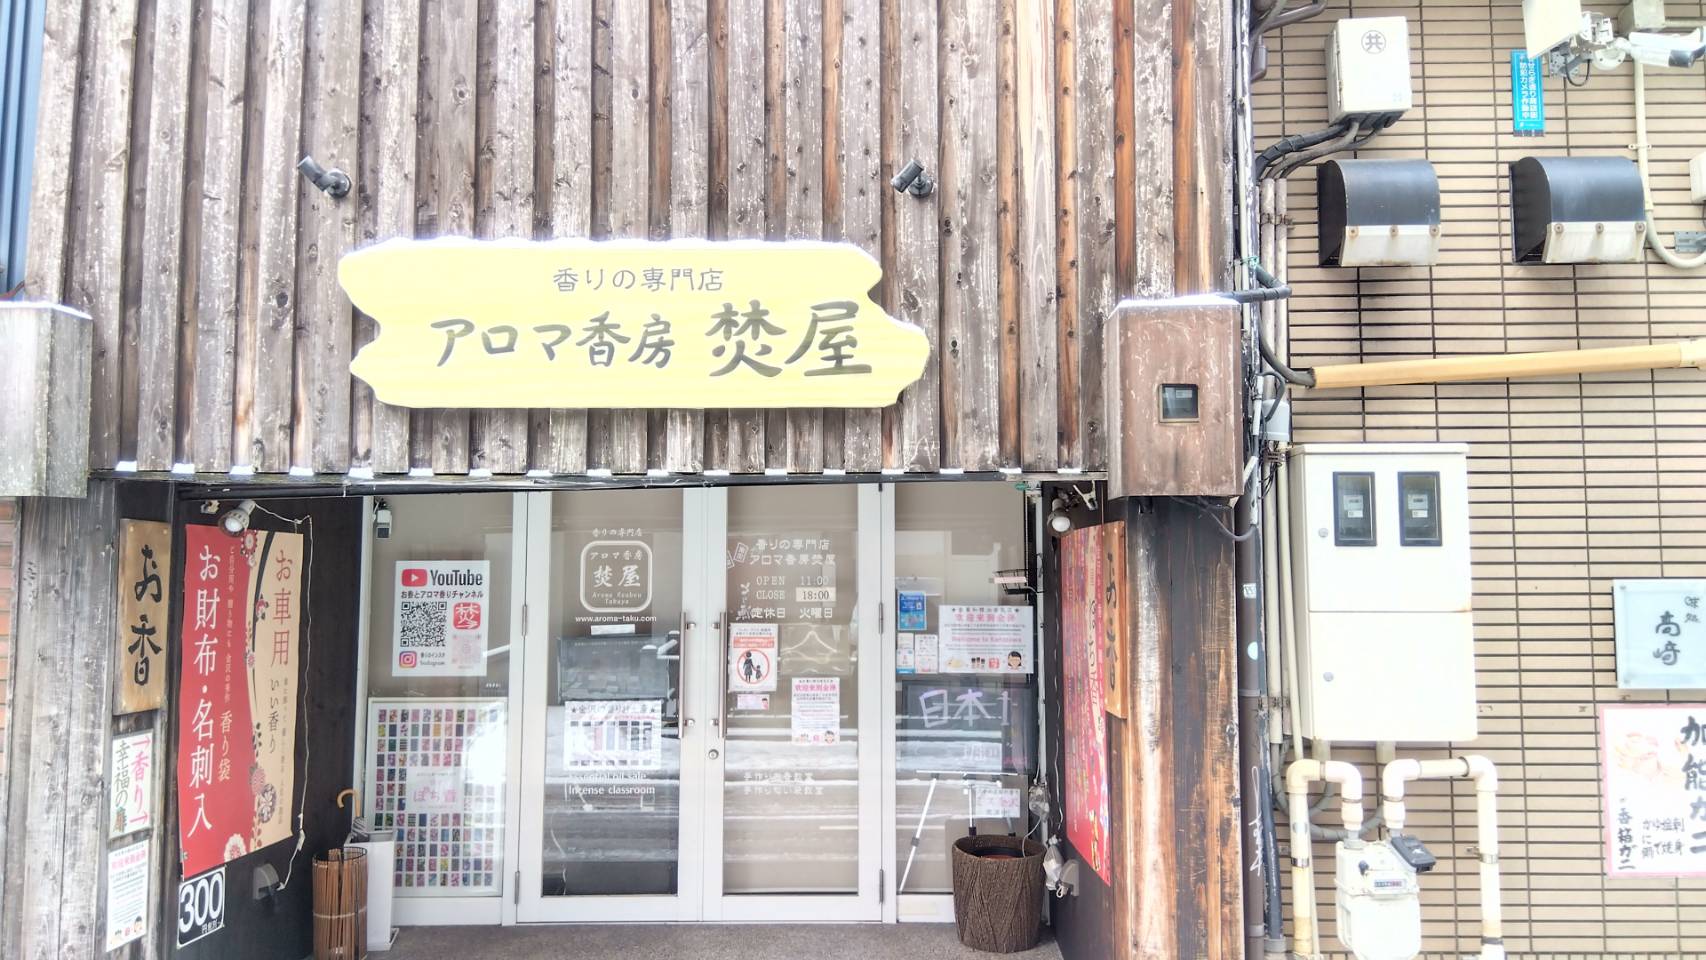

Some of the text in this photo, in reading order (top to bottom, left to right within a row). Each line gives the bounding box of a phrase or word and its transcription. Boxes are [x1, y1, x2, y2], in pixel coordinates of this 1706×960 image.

[553, 267, 723, 293] 香りの専門店
[430, 300, 872, 377] アロマ香房 焚屋
[756, 539, 830, 551] 香りの専門店
[430, 569, 483, 586] YouTube
[593, 565, 641, 588] 焚屋
[756, 576, 829, 586] OPEN 11:00
[756, 590, 829, 600] CLOSE 18:00
[128, 544, 162, 686] お香
[271, 550, 293, 667] お車用
[575, 614, 657, 623] www.aroma-taku.com
[750, 607, 833, 618] 定休日 火曜日
[187, 544, 222, 838] お財布・名刺入
[268, 679, 279, 754] いい香り
[130, 751, 149, 814] 香り
[569, 785, 655, 794] Incense classroom
[179, 873, 223, 933] 300
